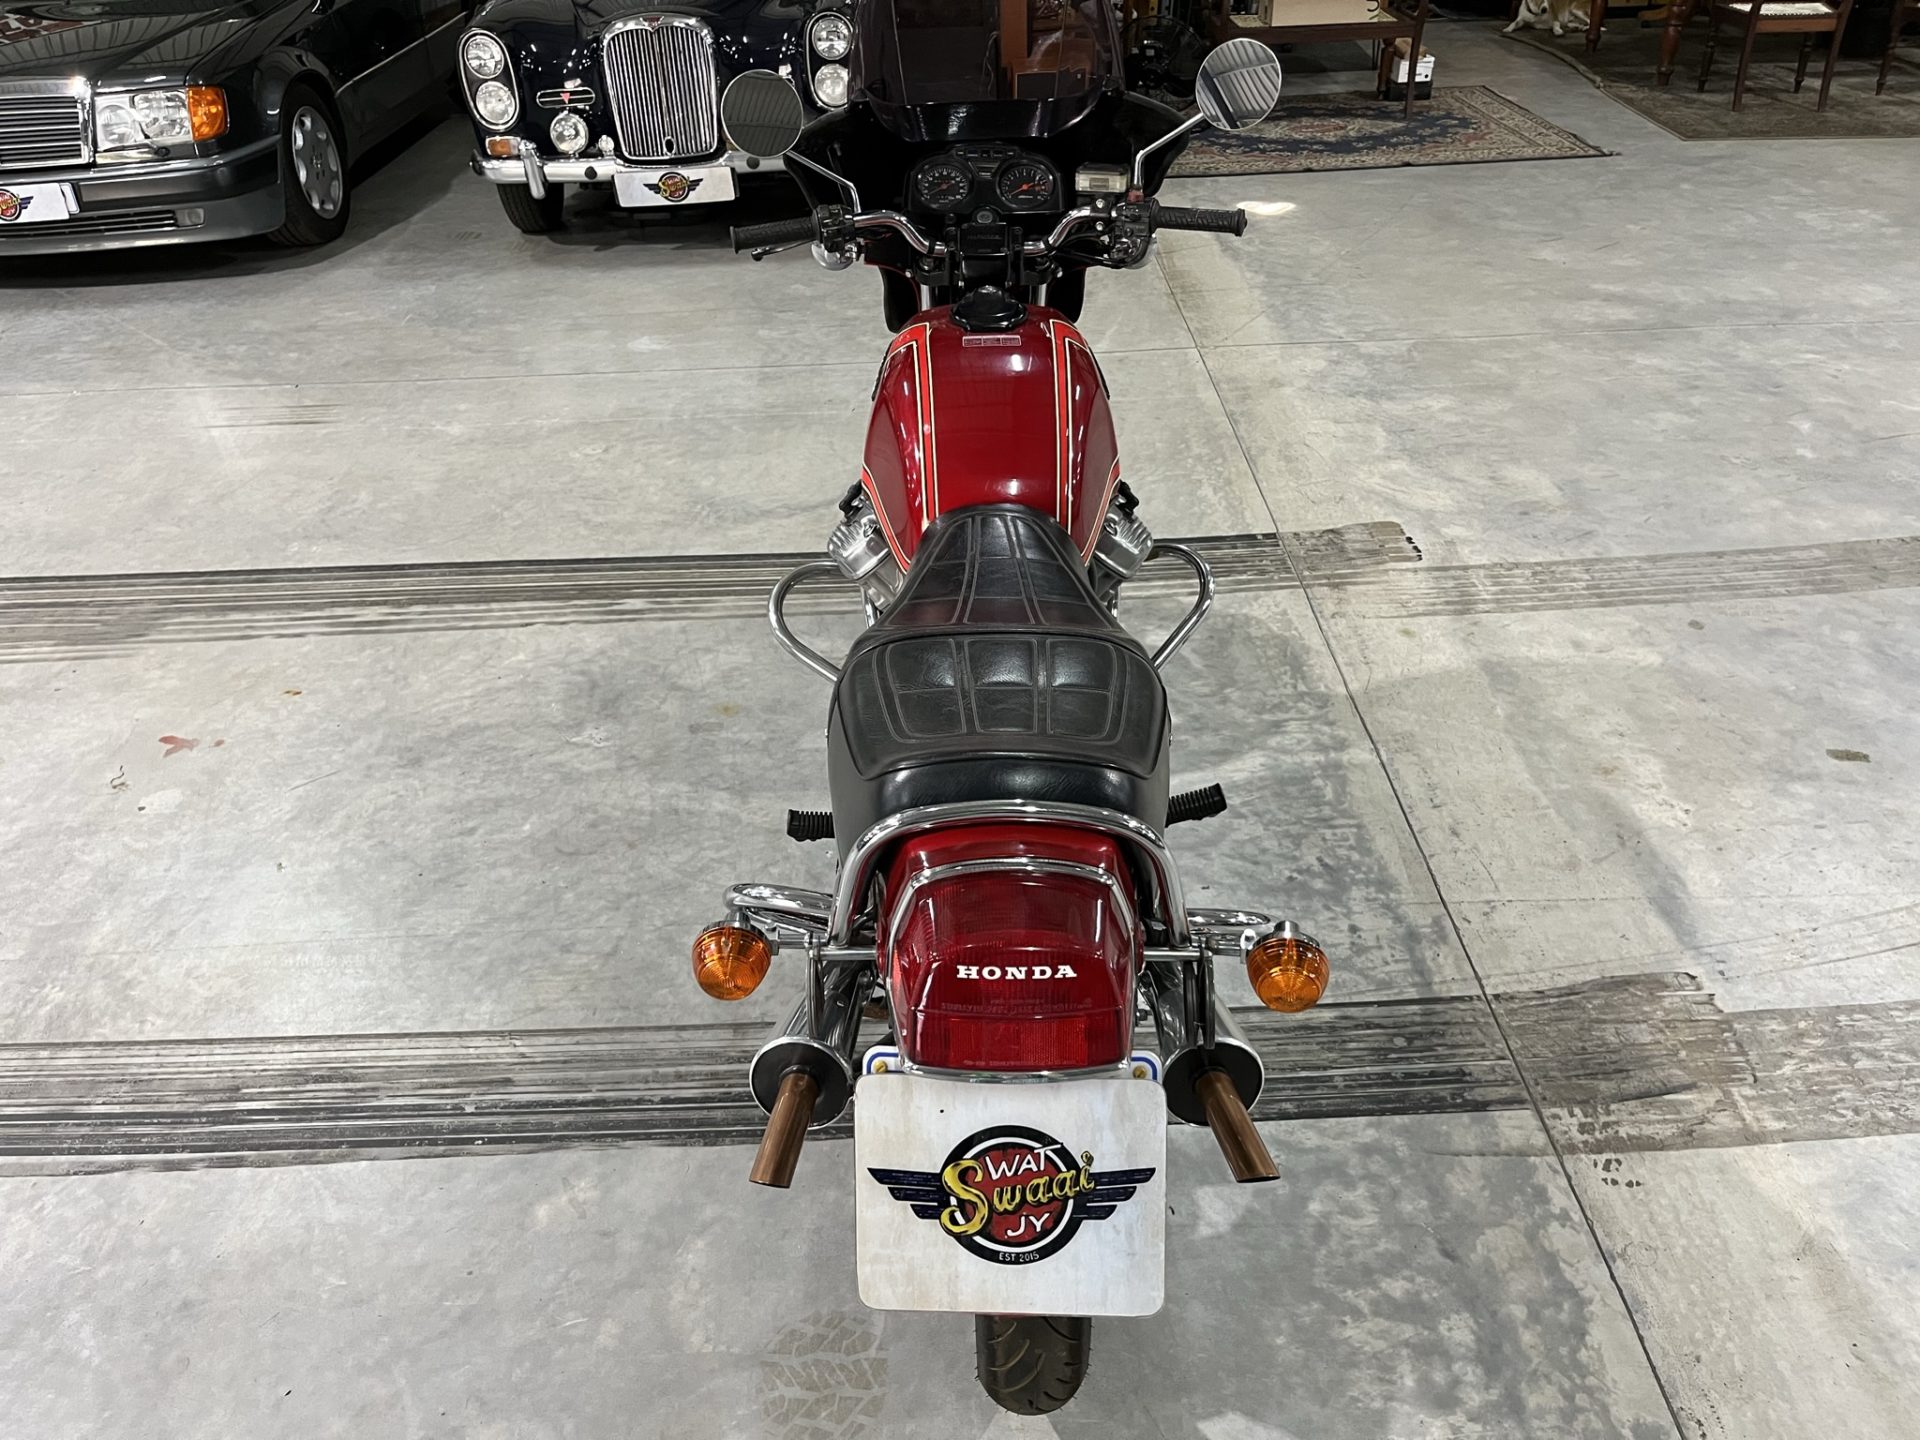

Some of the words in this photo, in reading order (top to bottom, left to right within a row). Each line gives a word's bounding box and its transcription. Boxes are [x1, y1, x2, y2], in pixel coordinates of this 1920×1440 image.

[956, 965, 1077, 980] HONDA
[985, 1143, 1062, 1181] WAT
[940, 1151, 1095, 1236] Swaai
[1007, 1213, 1050, 1236] JY
[999, 1252, 1017, 1262] EST
[1019, 1252, 1040, 1262] 2015
